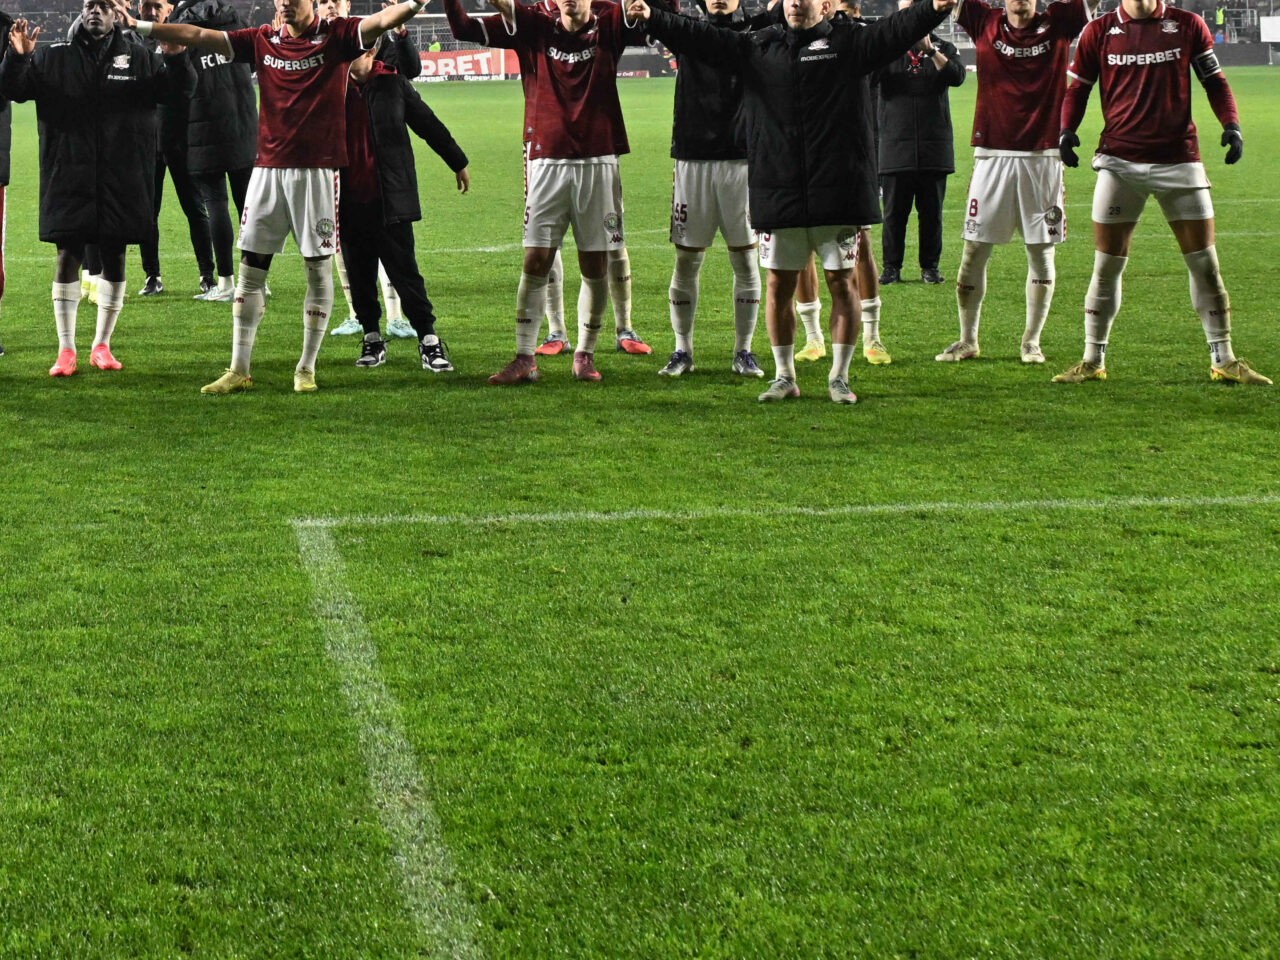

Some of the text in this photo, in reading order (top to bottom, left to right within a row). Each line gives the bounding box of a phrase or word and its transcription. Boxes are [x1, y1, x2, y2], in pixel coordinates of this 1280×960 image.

[547, 46, 598, 64] SUPERBE
[993, 40, 1052, 58] SUPERBET
[1107, 47, 1182, 66] SUPERBET
[200, 54, 216, 70] FC
[263, 53, 325, 72] SUPERBET
[969, 198, 978, 217] 8
